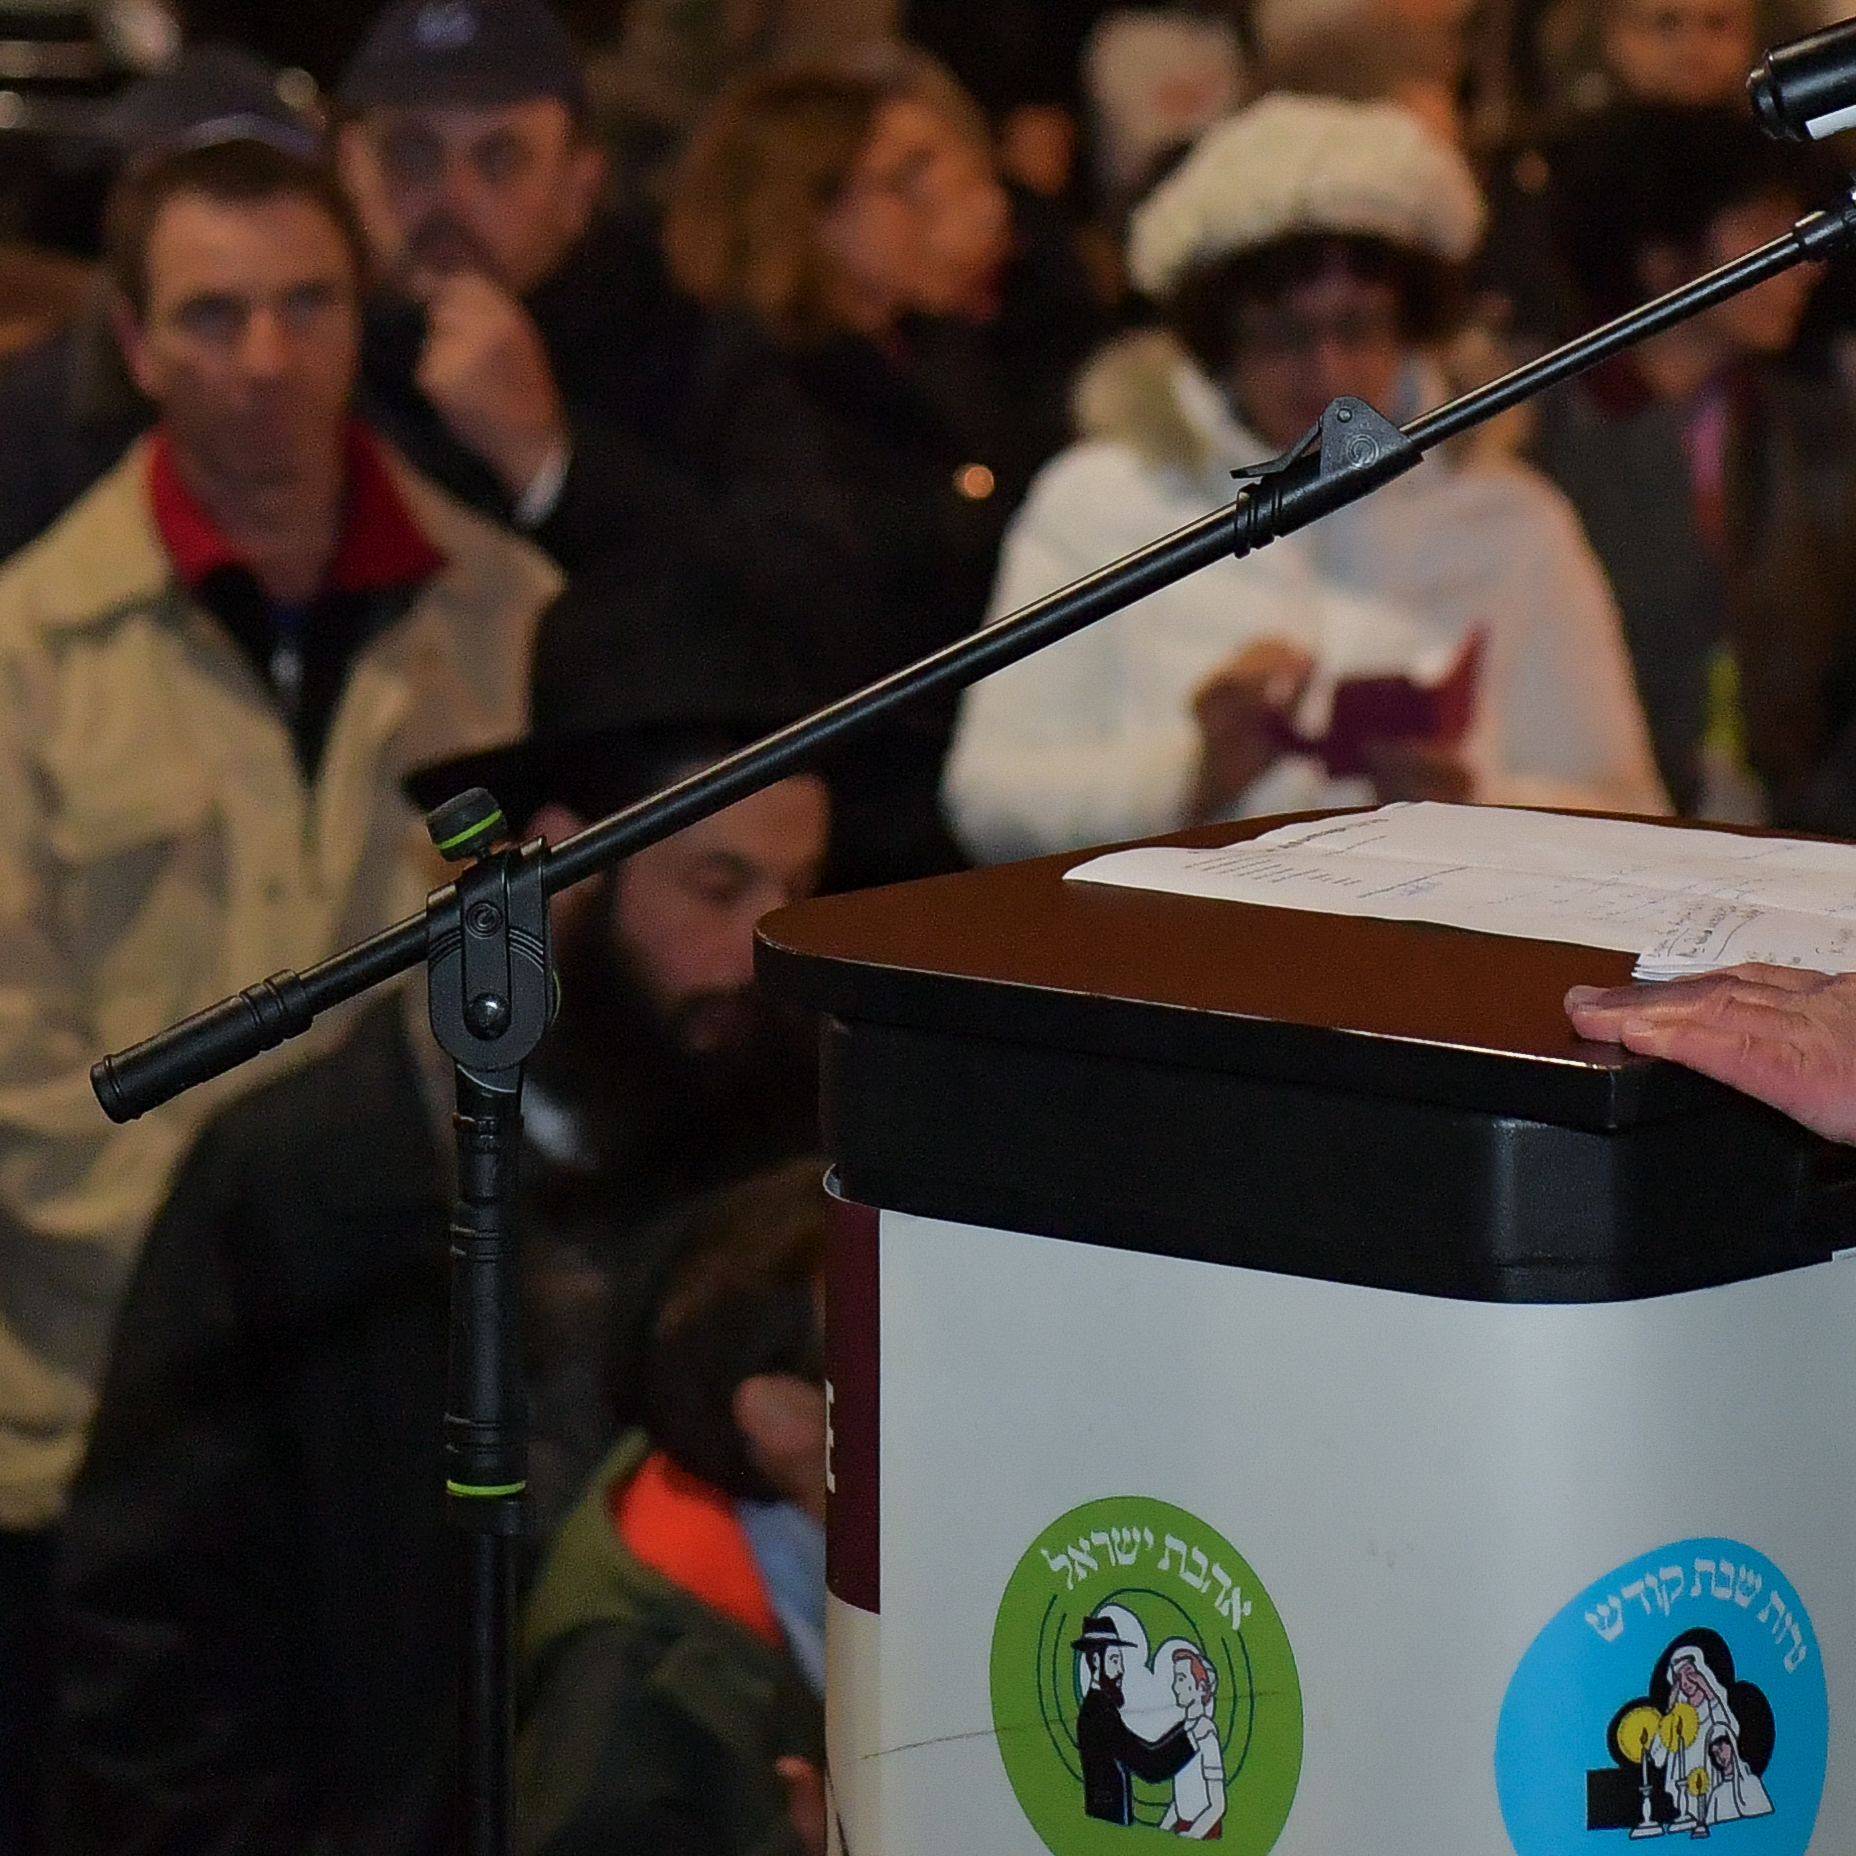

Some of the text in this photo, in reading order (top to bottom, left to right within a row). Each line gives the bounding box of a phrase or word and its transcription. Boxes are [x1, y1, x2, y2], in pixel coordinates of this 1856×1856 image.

[1040, 1526, 1252, 1630] אהבת ישראל
[1584, 1557, 1807, 1674] נרות שבת קודש
